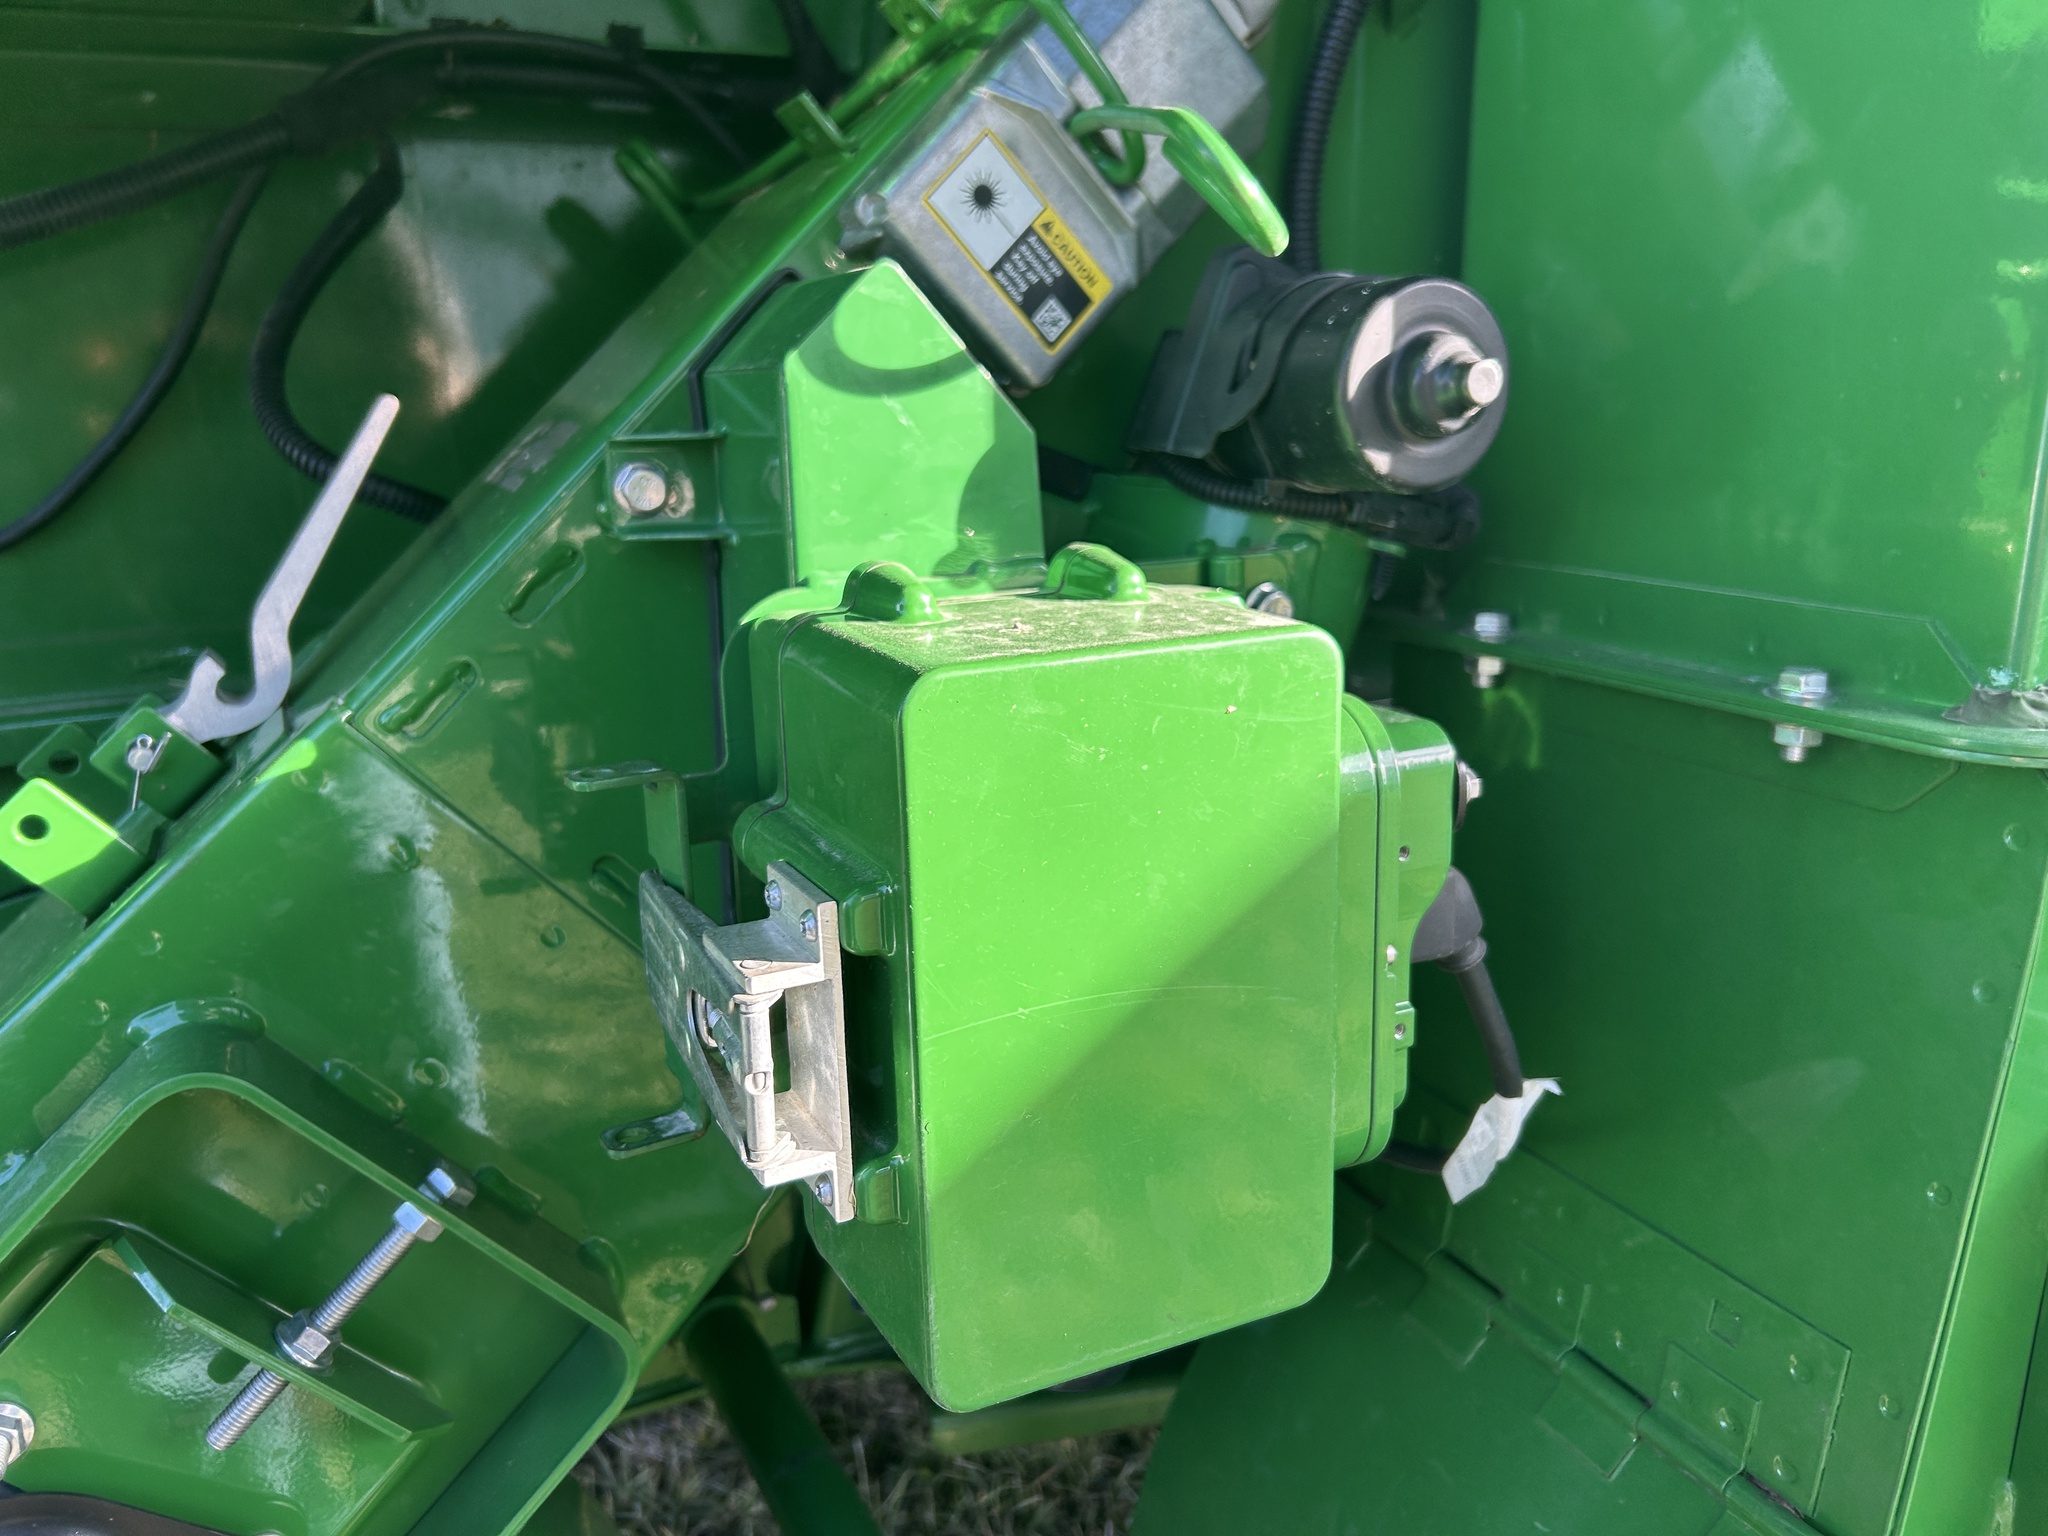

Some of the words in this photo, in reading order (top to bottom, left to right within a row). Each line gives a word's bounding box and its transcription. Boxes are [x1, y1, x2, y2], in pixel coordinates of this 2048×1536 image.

[1011, 252, 1029, 272] Key
[1025, 269, 1041, 285] off
[1026, 235, 1052, 261] Avoid
[1046, 259, 1064, 278] eye
[1053, 234, 1097, 288] CAUTION
[1002, 260, 1029, 292] during
